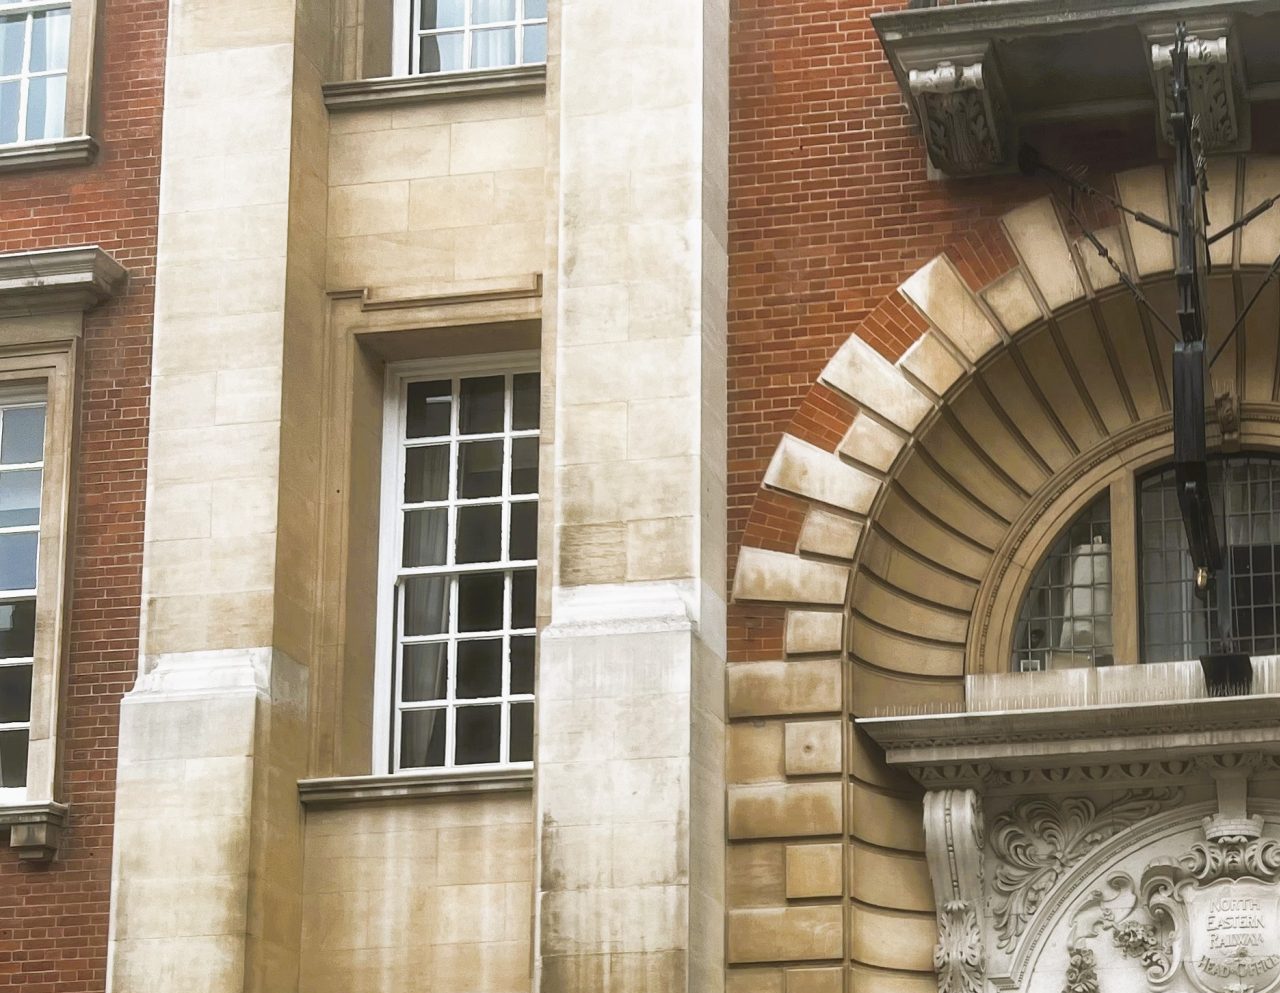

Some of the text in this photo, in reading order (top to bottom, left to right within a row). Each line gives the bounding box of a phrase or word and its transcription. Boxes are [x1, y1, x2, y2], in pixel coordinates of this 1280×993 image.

[1209, 898, 1261, 913] NORTH
[1206, 915, 1265, 931] EASTERN
[1209, 933, 1264, 949] RAILWAY
[1198, 954, 1230, 978] HEAD
